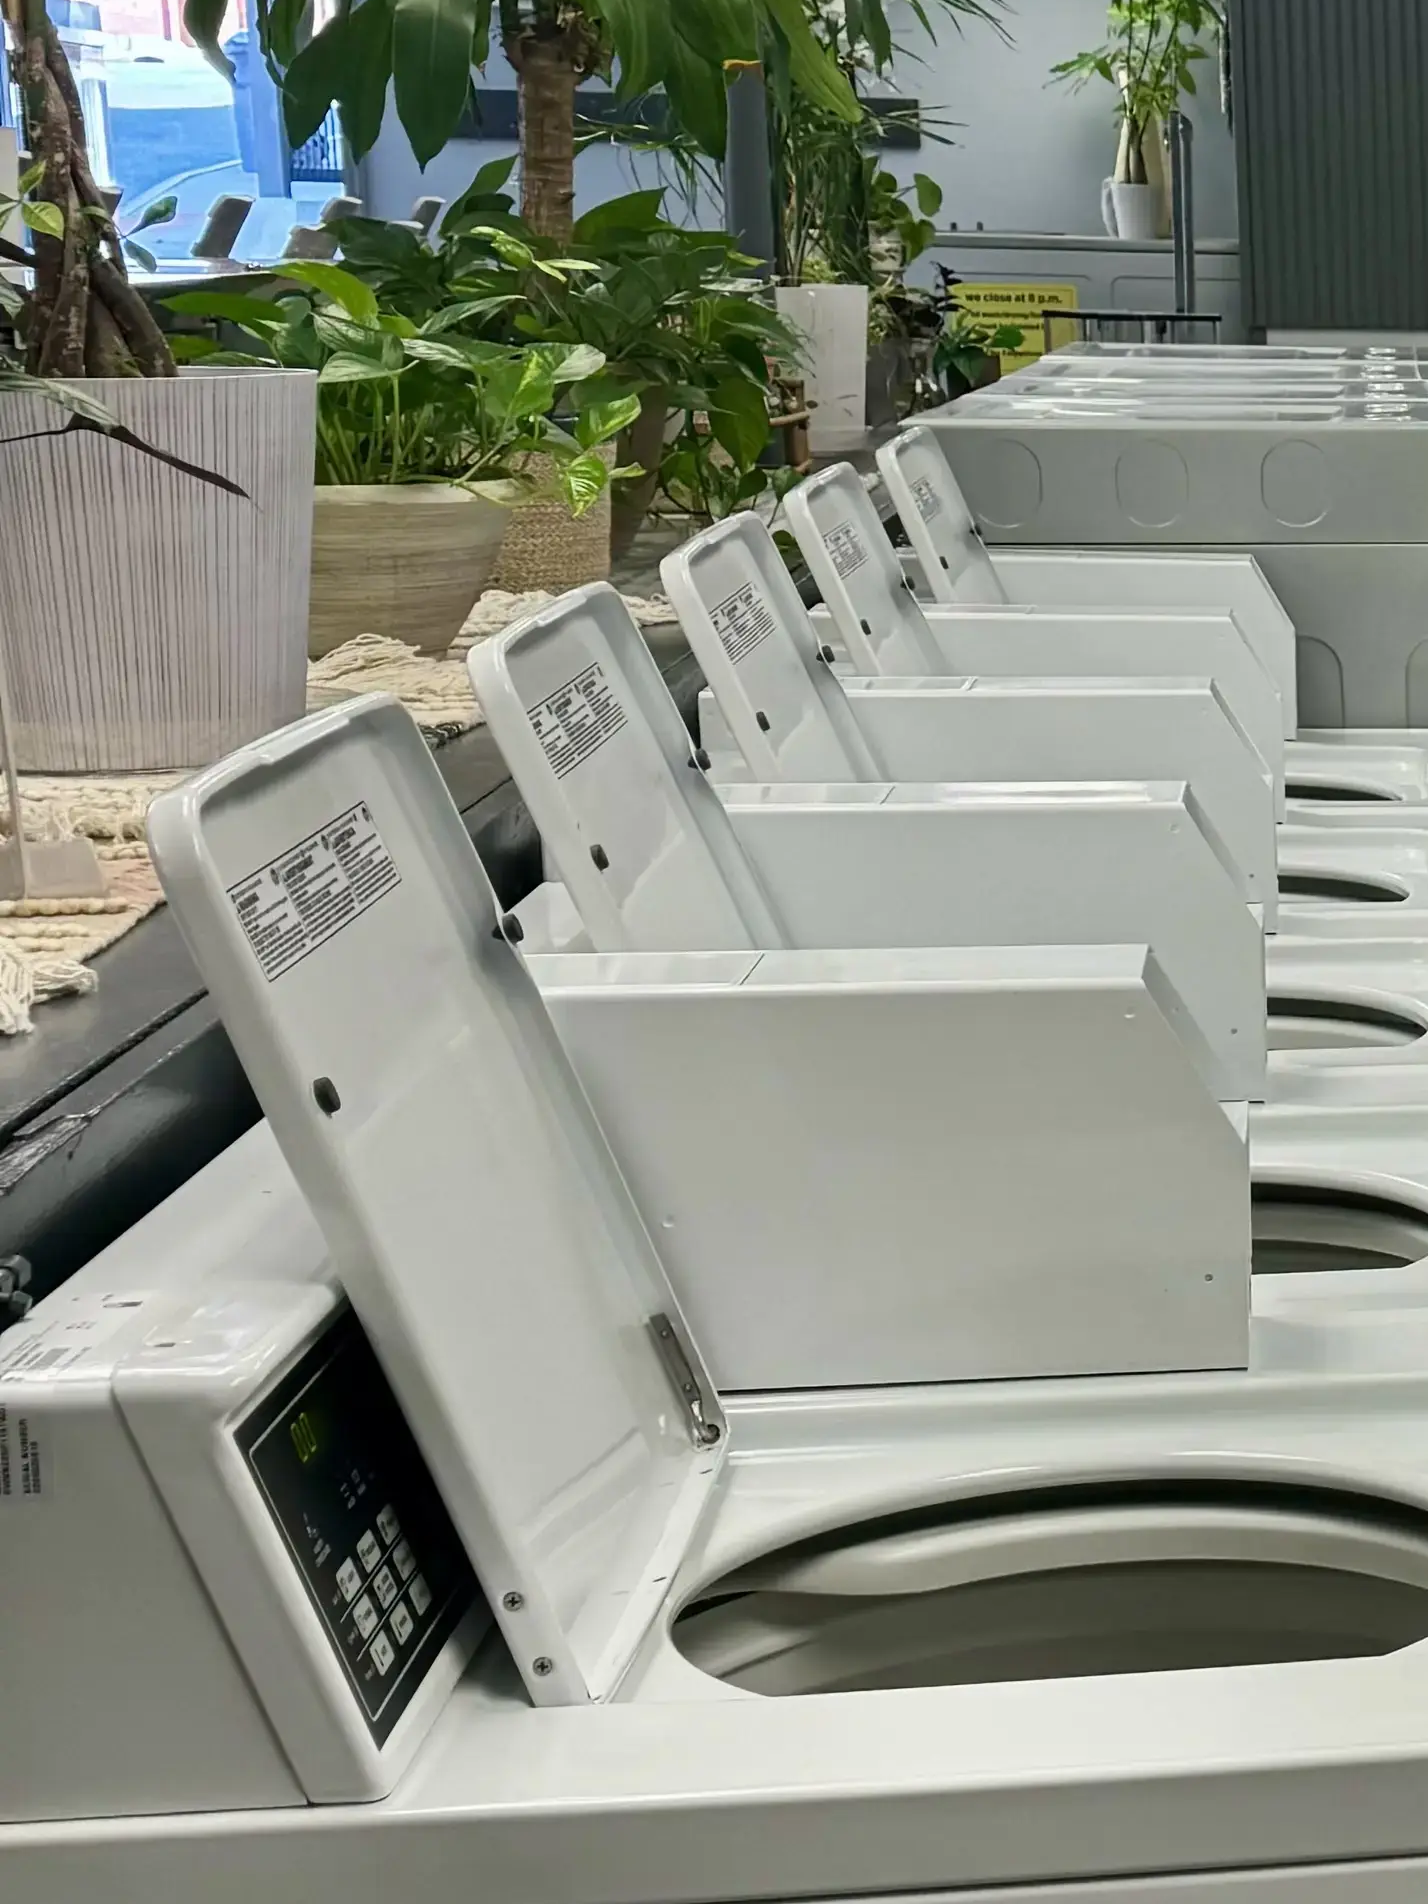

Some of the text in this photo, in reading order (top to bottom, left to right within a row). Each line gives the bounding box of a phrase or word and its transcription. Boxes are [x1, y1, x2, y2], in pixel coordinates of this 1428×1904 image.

[965, 294, 981, 302] we
[983, 293, 1012, 302] close
[1014, 293, 1026, 303] at
